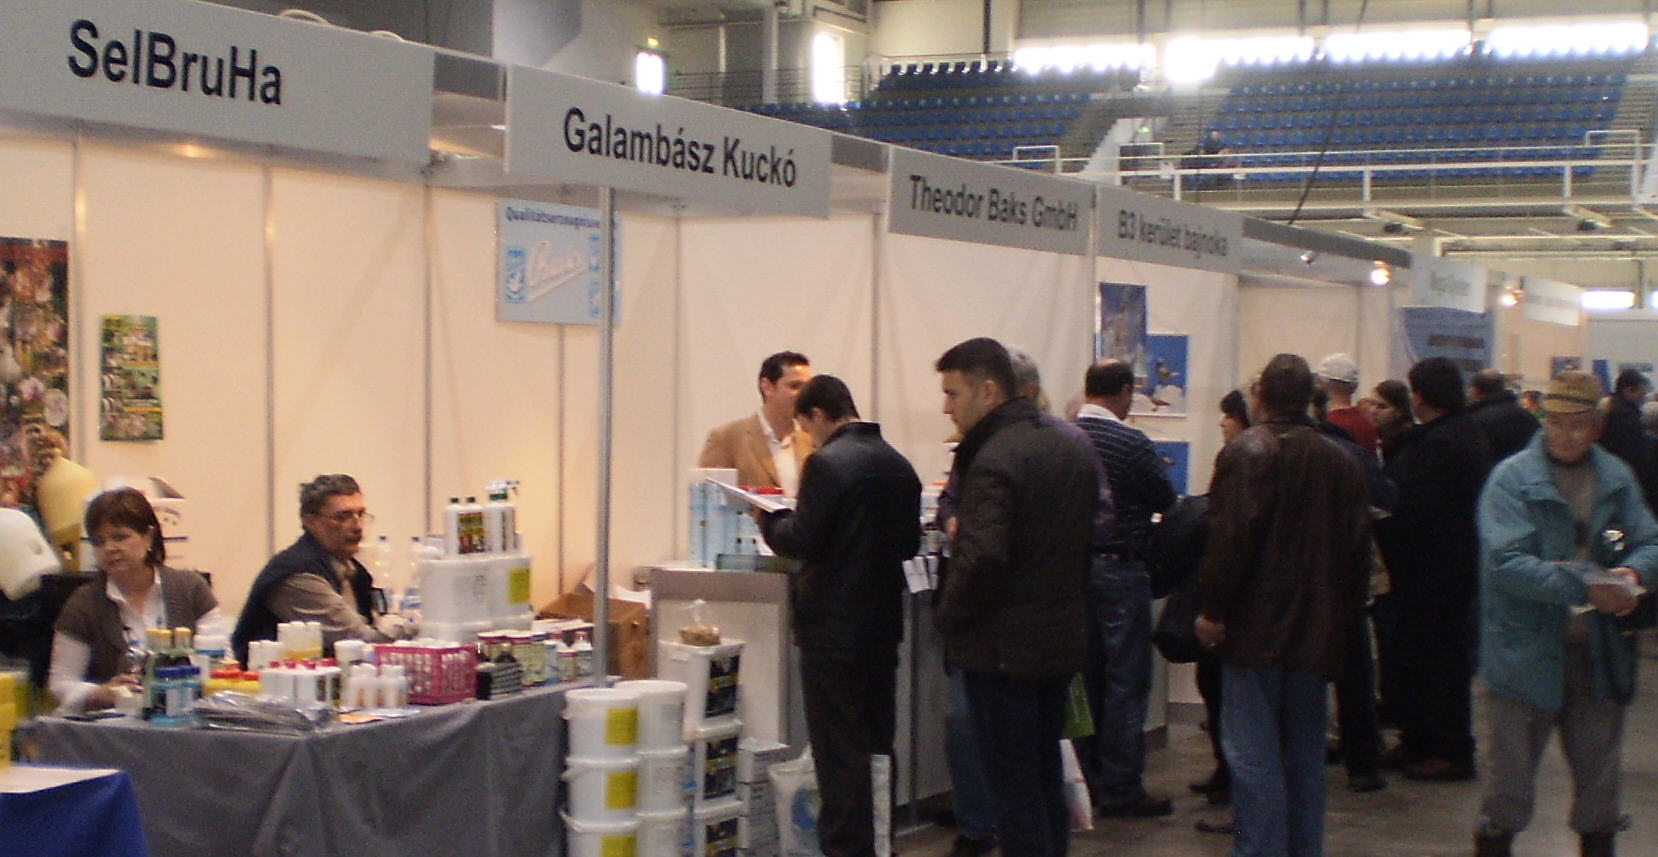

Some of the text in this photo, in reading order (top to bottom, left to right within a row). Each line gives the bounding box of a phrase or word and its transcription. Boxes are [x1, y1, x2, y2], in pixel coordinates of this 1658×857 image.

[68, 19, 282, 105] SelBruHa
[564, 107, 796, 187] Galambász Kuckó
[909, 174, 1079, 232] Theodor Baks GmbH
[1139, 212, 1181, 249] kerület
